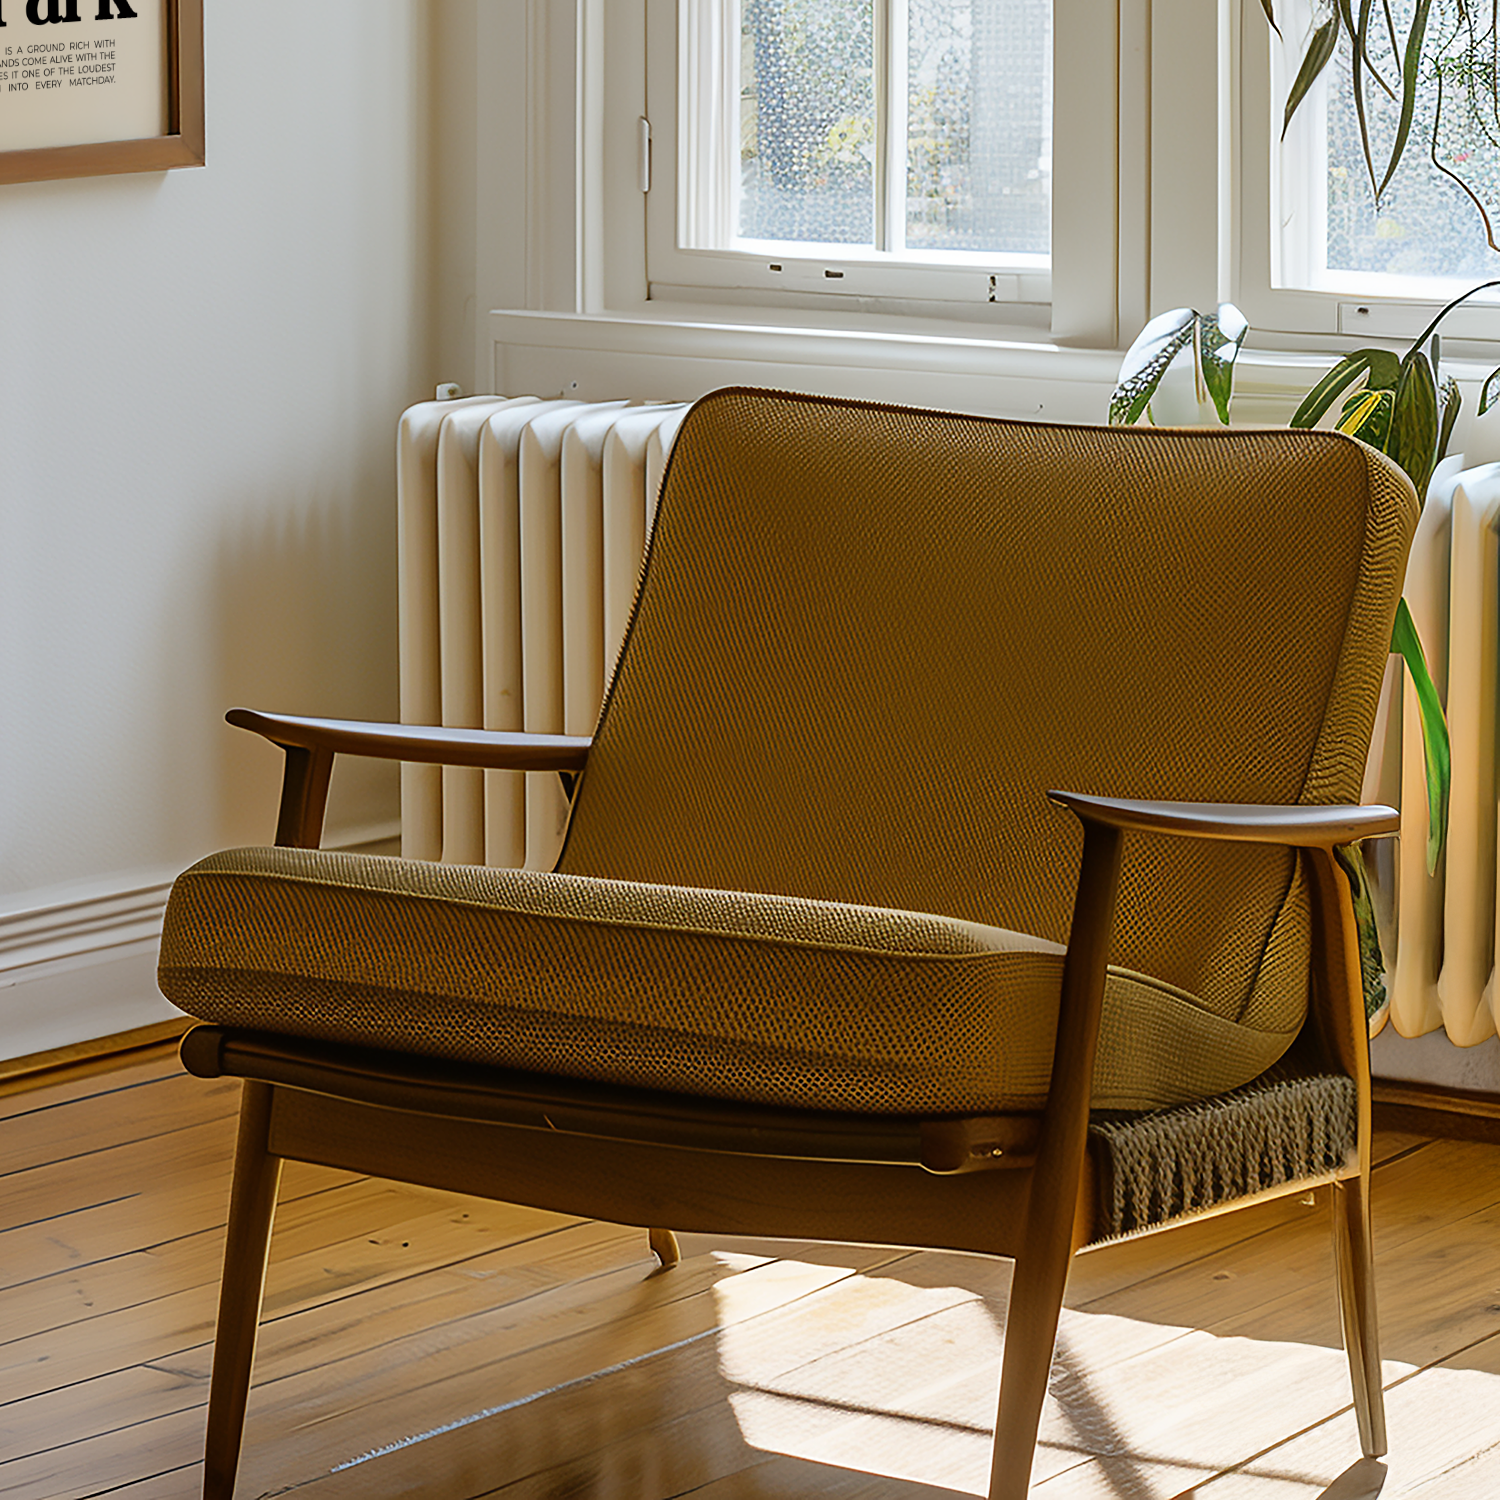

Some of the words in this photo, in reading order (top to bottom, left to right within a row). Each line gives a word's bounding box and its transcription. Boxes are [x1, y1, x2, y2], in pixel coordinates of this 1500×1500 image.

[5, 47, 13, 56] IS
[16, 46, 23, 55] A
[27, 43, 66, 54] GROUND
[69, 41, 90, 51] RICH
[93, 39, 116, 49] WITH
[22, 57, 48, 67] COME
[49, 55, 73, 65] ALIVE
[75, 53, 97, 63] WITH
[99, 51, 116, 61] THE
[11, 71, 19, 80] IT
[22, 69, 41, 79] ONE
[43, 68, 56, 78] OF
[58, 67, 75, 76] THE
[78, 63, 116, 75] LOUDEST
[8, 82, 29, 93] INTO
[35, 80, 63, 91] EVERY
[69, 76, 116, 88] MATCHDAY.
